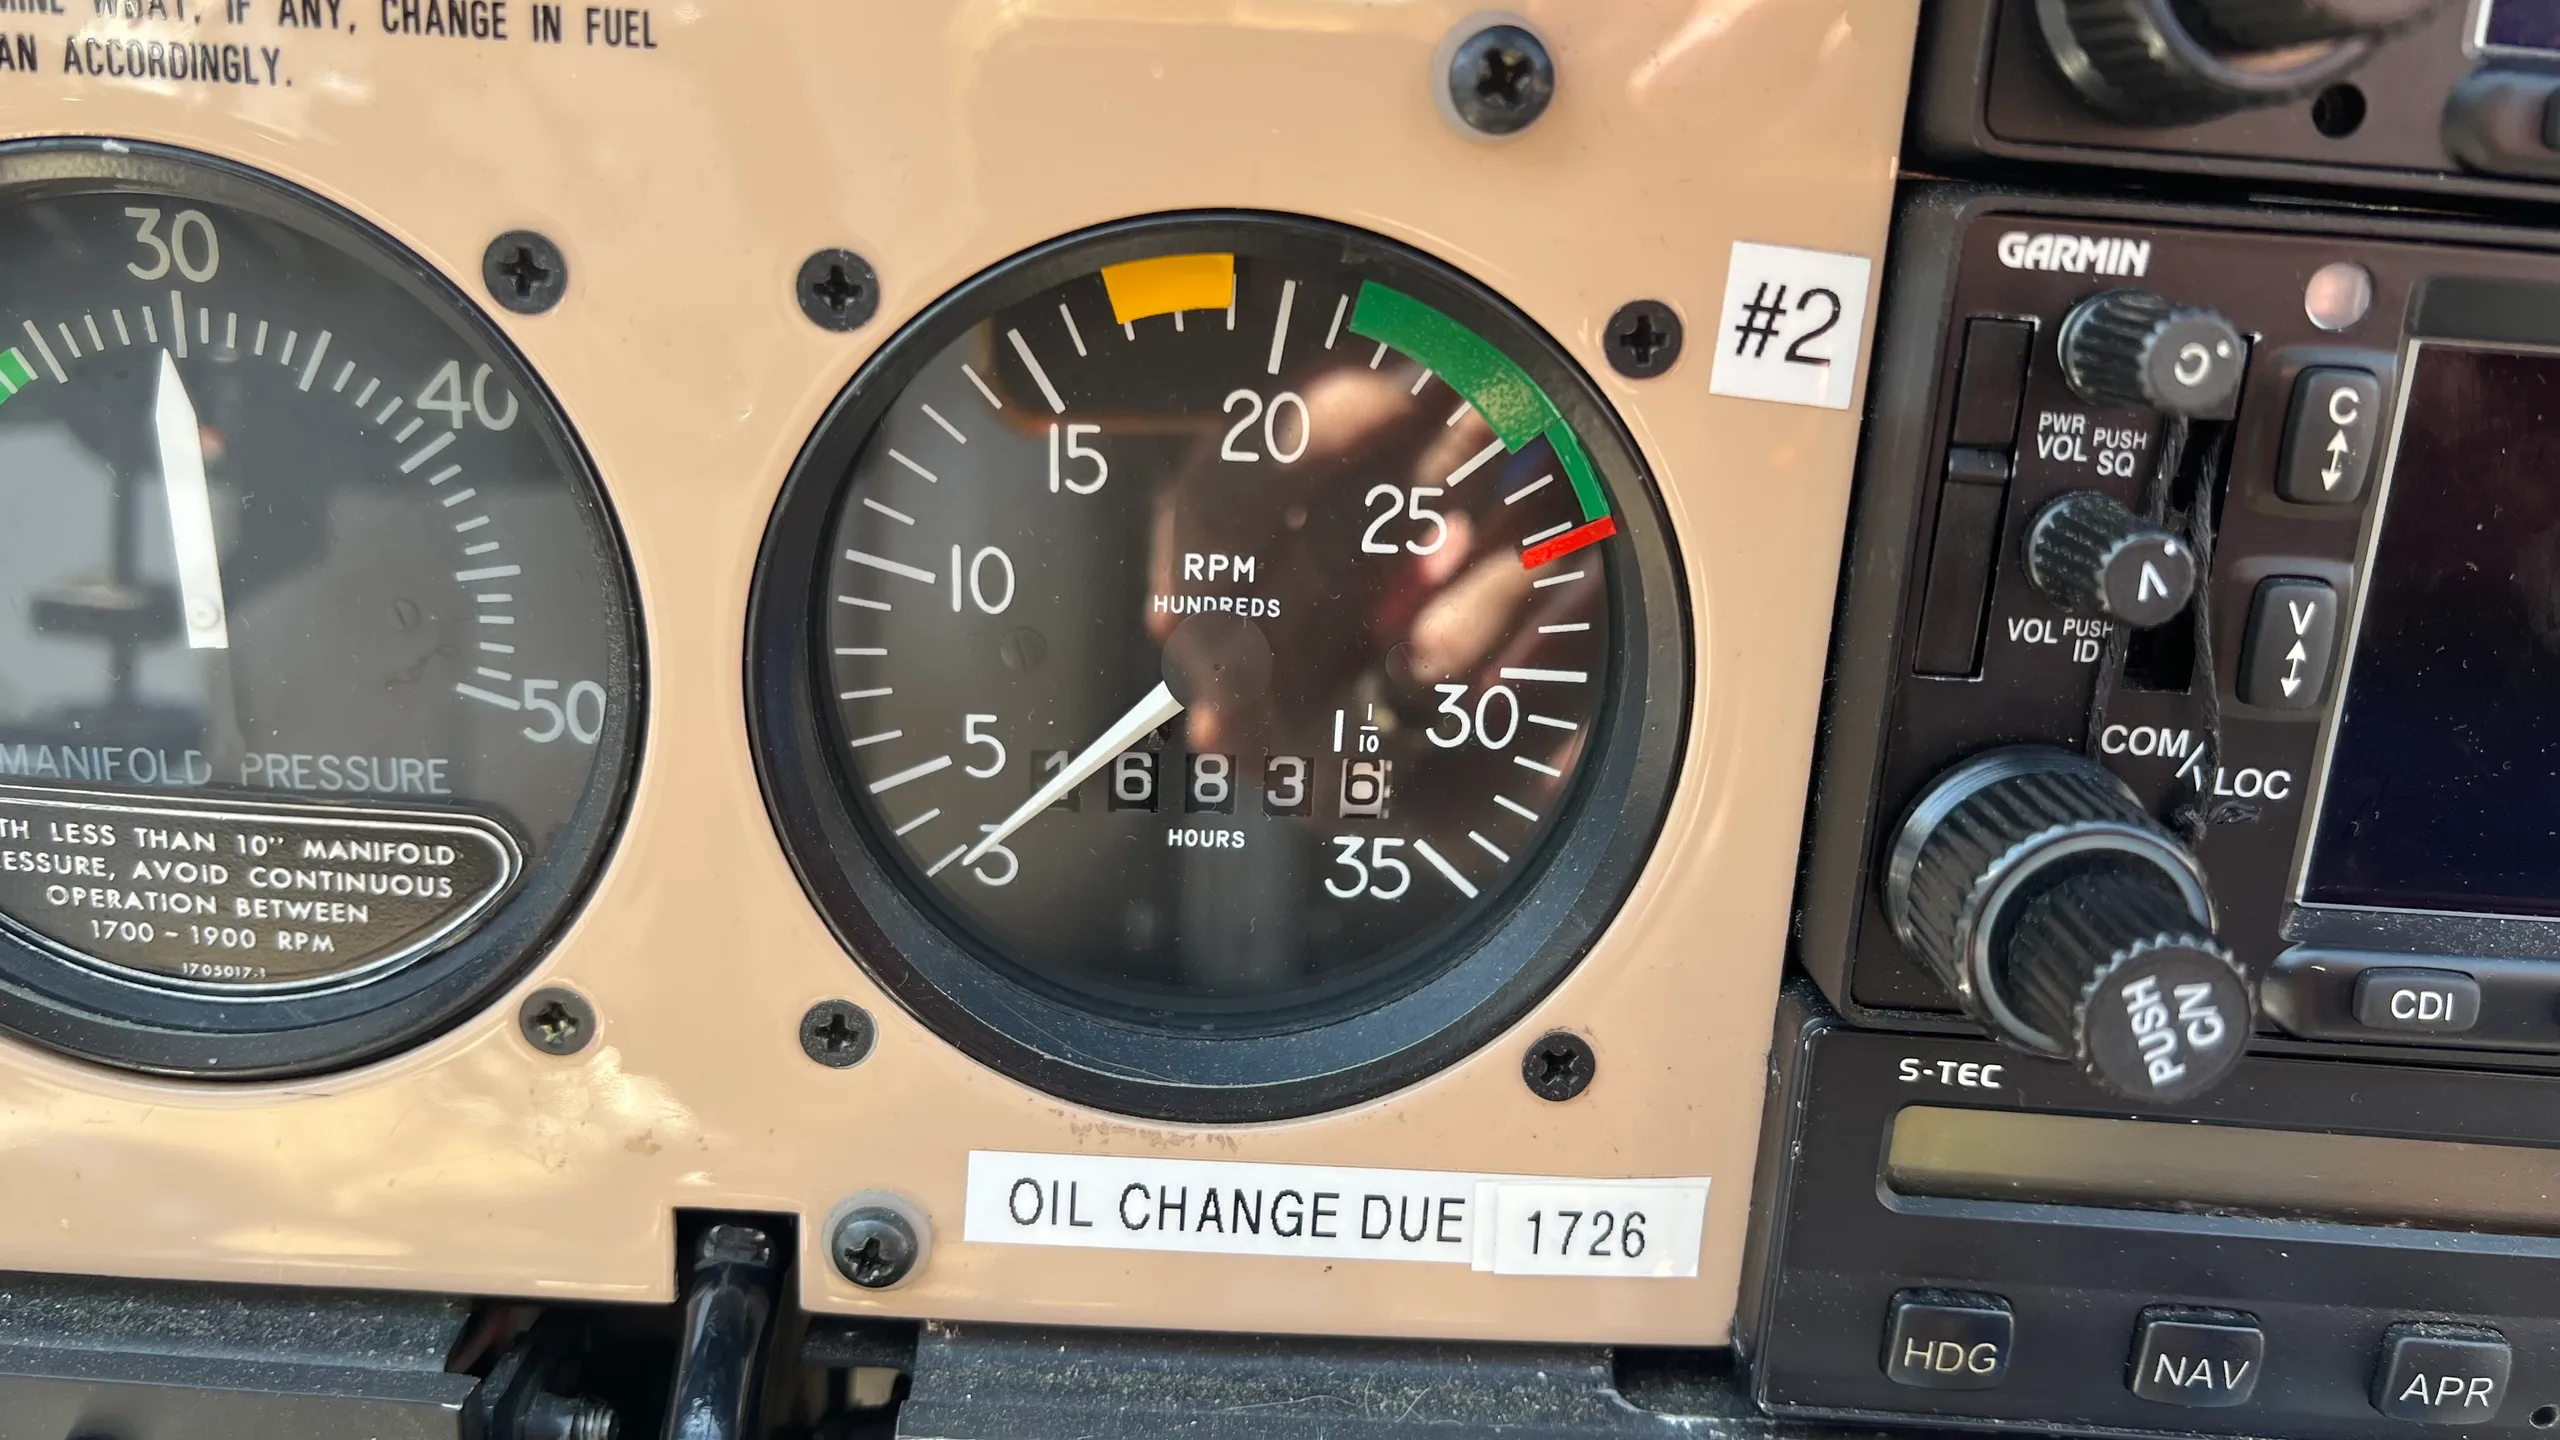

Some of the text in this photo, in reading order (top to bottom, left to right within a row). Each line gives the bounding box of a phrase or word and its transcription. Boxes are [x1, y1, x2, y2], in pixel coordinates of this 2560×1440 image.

[279, 0, 356, 34] ANY,
[382, 0, 508, 40] CHANGE
[533, 5, 563, 43] IN
[587, 8, 659, 48] FUEL
[64, 36, 292, 87] ACCORDINGLY.
[125, 207, 219, 283] 30
[1998, 231, 2149, 277] GARMIN
[1735, 281, 1842, 367] #2
[417, 360, 519, 431] 40
[2328, 388, 2359, 426] C
[1221, 389, 1310, 463] 20
[2038, 411, 2086, 435] PWR
[2093, 427, 2147, 450] PUSH
[1050, 423, 1108, 494] 15
[2037, 434, 2088, 462] VOL
[2096, 450, 2136, 478] SQ
[1361, 484, 1447, 554] 25
[952, 544, 1015, 614] 10
[1184, 553, 1256, 583] RPM
[1154, 595, 1281, 618] HUNDREDS
[2288, 600, 2316, 636] V
[2007, 617, 2058, 644] VOL
[2072, 638, 2099, 663] ID
[524, 679, 607, 744] 50
[1426, 684, 1519, 750] 30
[966, 714, 1006, 778] 5
[0, 742, 452, 794] MANIFOLD PRESSURE
[51, 822, 116, 846] LESS
[134, 827, 216, 852] THAN
[303, 839, 455, 867] MANIFOLD
[1168, 828, 1245, 849] HOURS
[132, 860, 229, 885] AVOID
[249, 866, 453, 898] CONTINUOUS
[1325, 836, 1411, 900] 35
[46, 884, 368, 924] OPERATION BETWEEN
[91, 919, 155, 943] 1700
[191, 925, 257, 949] 1900
[278, 930, 335, 953] RPM
[2390, 991, 2454, 1022] CDI
[2121, 974, 2187, 1088] PUSH
[1898, 1057, 2004, 1089] S-TEC
[1009, 1176, 1646, 1259] OIL CHANGE DUE 1726
[1904, 1340, 1998, 1374] HDG
[2153, 1353, 2251, 1390] NAV
[2399, 1373, 2495, 1409] APR
